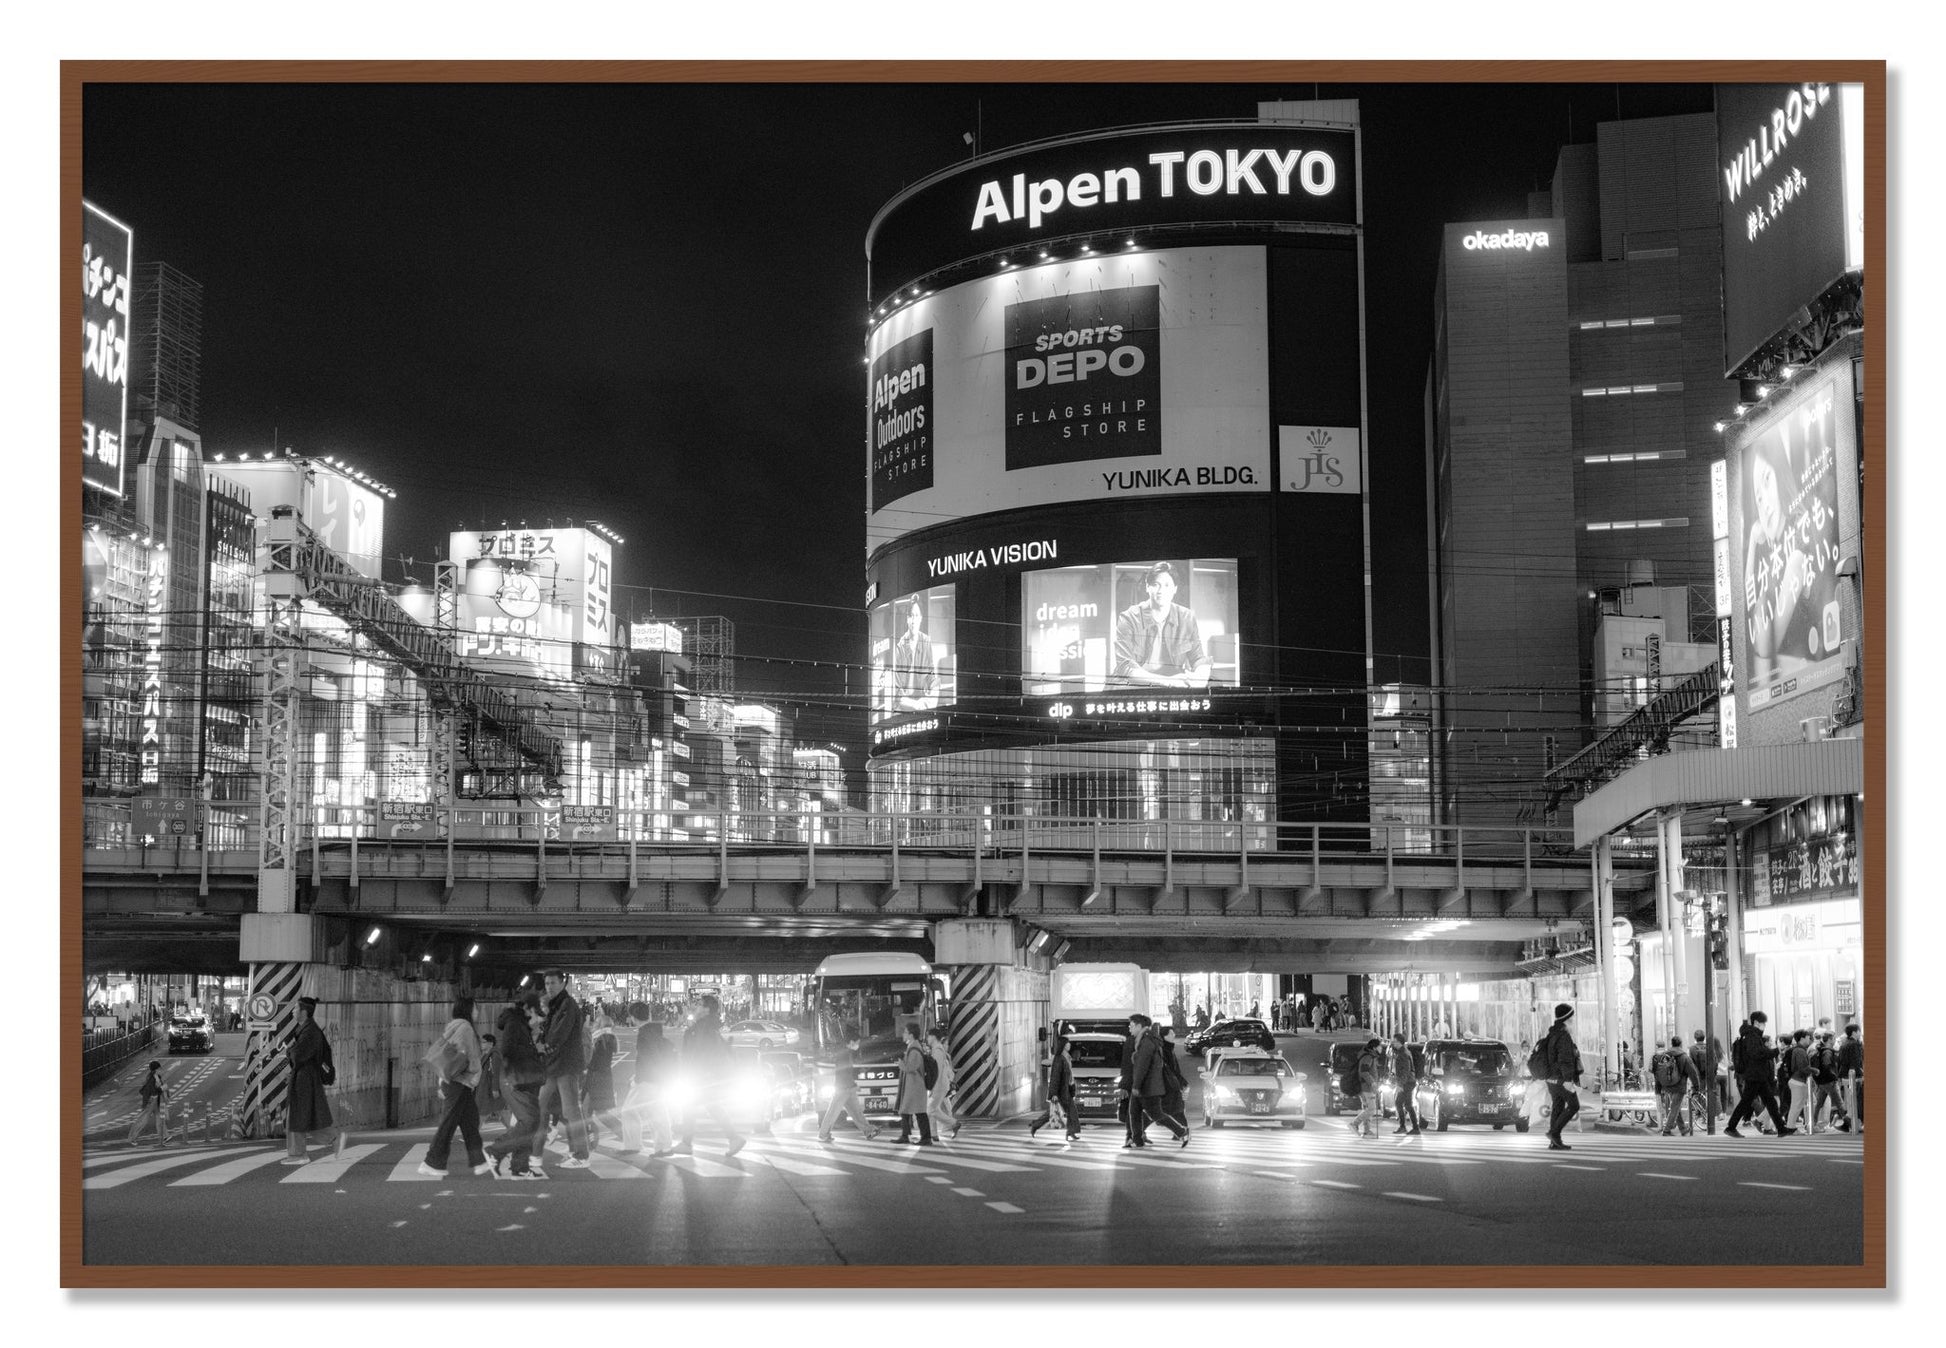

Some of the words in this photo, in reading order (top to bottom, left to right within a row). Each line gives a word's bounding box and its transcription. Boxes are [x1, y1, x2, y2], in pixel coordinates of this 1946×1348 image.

[971, 167, 1141, 230] Alpen
[1149, 149, 1336, 197] TOKYO
[1463, 228, 1549, 251] okadaya
[1035, 325, 1123, 352] SPORTS
[1017, 345, 1145, 390] DEPO
[874, 363, 926, 413] Alpen
[1016, 399, 1146, 426] FLAGSHIP
[877, 405, 925, 449] Outdoors
[1063, 418, 1146, 438] STORE
[874, 436, 927, 473] FLAGSHIP
[888, 455, 927, 481] STORE
[1102, 468, 1191, 492] YUNIKA
[1197, 466, 1259, 487] BLDG.
[217, 540, 250, 562] SHISHA
[478, 535, 556, 555] プロミス
[1746, 497, 1834, 611] 自分本位でも、
[927, 549, 987, 578] YUNIKA
[990, 539, 1058, 566] VISION
[1036, 602, 1098, 621] dream
[1049, 703, 1074, 719] dip
[382, 803, 432, 814] 新宿駅東口
[563, 806, 611, 817] 新宿駅東口
